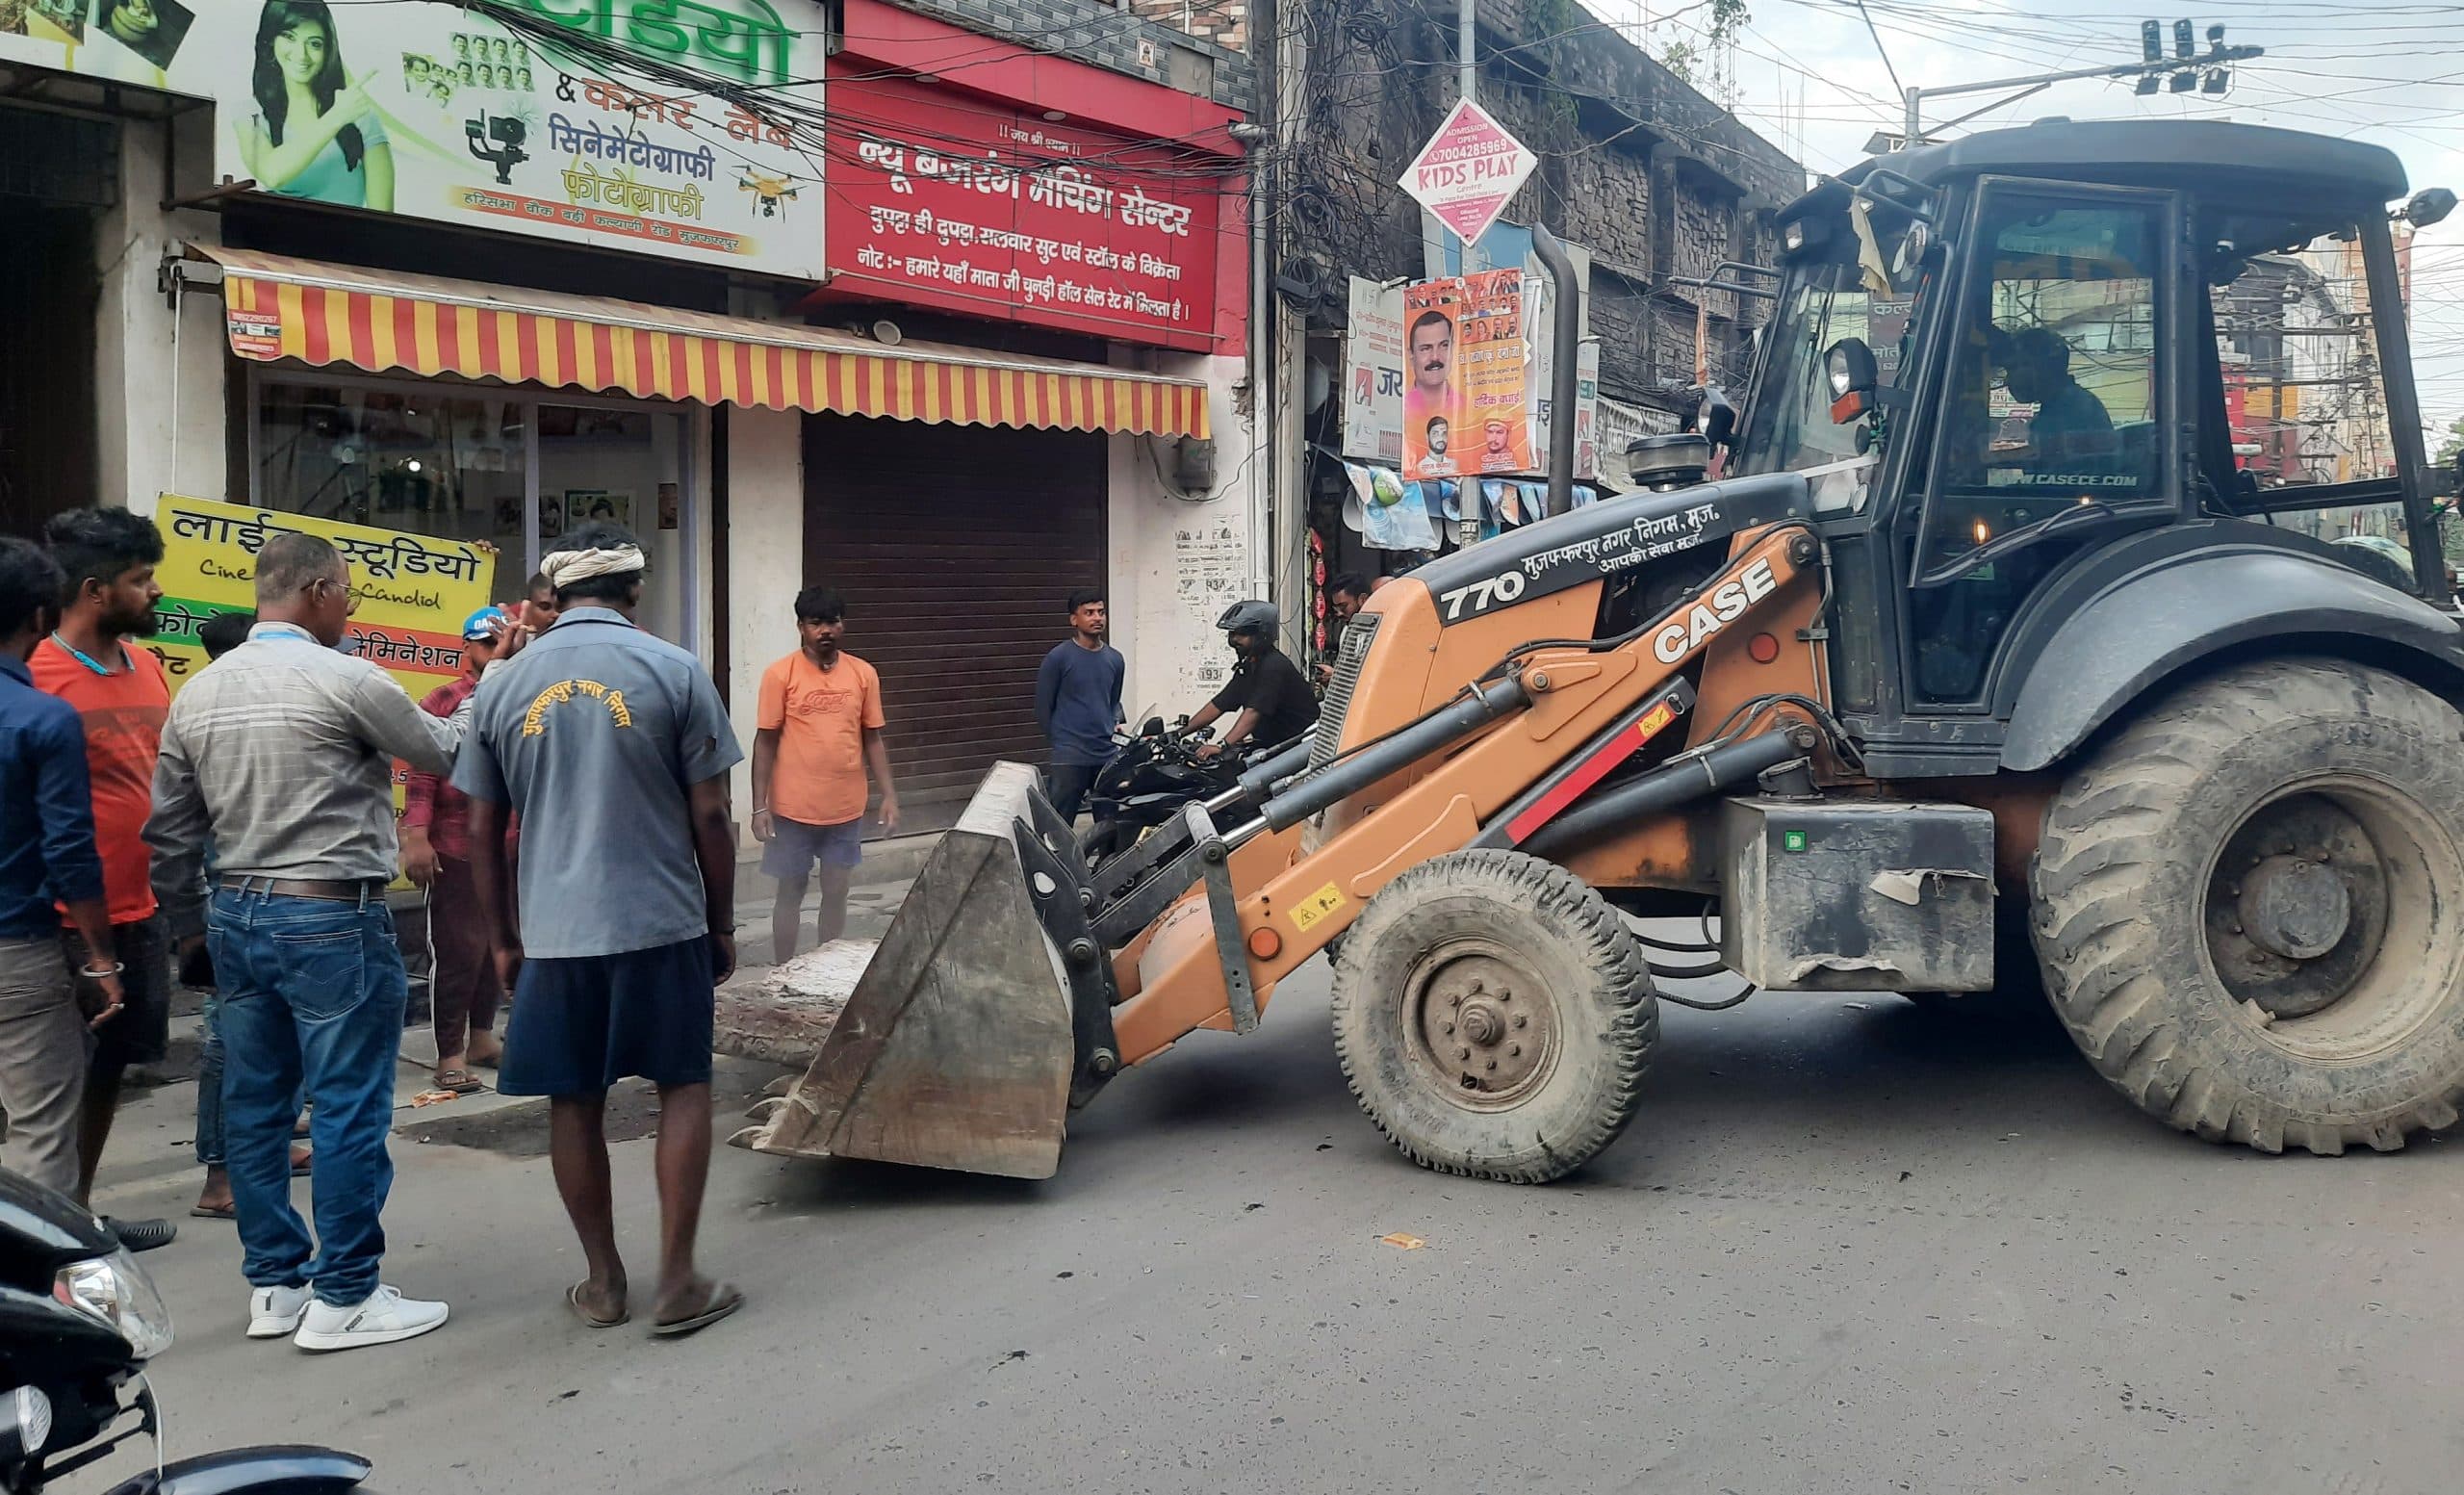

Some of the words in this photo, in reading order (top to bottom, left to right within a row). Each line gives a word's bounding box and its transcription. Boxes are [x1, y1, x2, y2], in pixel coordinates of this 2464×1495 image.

[555, 73, 576, 103] &
[581, 77, 698, 130] कलर
[548, 113, 715, 181] सिनेमेटोग्राफी
[1010, 128, 1029, 142] जय
[1031, 131, 1043, 145] श्री
[1439, 139, 1507, 162] 7004285969
[1446, 123, 1488, 137] ADMISSION
[1457, 135, 1478, 144] OPEN
[561, 163, 705, 219] फोटोग्राफी
[857, 132, 913, 194] न्यू
[1119, 185, 1192, 237] सेन्टर
[1418, 163, 1467, 192] KIDS
[1474, 154, 1519, 181] PLAY
[1456, 183, 1482, 193] Centre
[463, 193, 516, 210] हरिसभा
[524, 200, 554, 218] चौक
[651, 223, 671, 237] रोड
[870, 205, 911, 234] दुपट्टा
[913, 208, 933, 234] ही
[1061, 241, 1082, 262] एवं
[1084, 245, 1119, 270] स्टॉल
[1121, 252, 1137, 271] के
[1139, 252, 1181, 280] विक्रेता
[857, 244, 885, 270] नोट
[905, 255, 940, 279] हमारे
[942, 259, 970, 284] यहाँ
[970, 268, 1000, 288] माता
[1002, 269, 1020, 292] जी
[1058, 280, 1082, 303] हॉल
[1084, 285, 1106, 307] सेल
[1107, 287, 1122, 308] रेट
[1122, 290, 1137, 311] में
[1136, 292, 1170, 318] मिलता
[1598, 547, 1649, 573] आपकी
[1647, 541, 1675, 558] सेवा
[1602, 528, 1632, 554] नगर
[199, 558, 255, 580] Cine
[359, 581, 443, 609] Candid
[1441, 569, 1526, 621] 770
[1654, 556, 1779, 664] CASE
[575, 678, 608, 700] नगर
[603, 689, 632, 729] निगम
